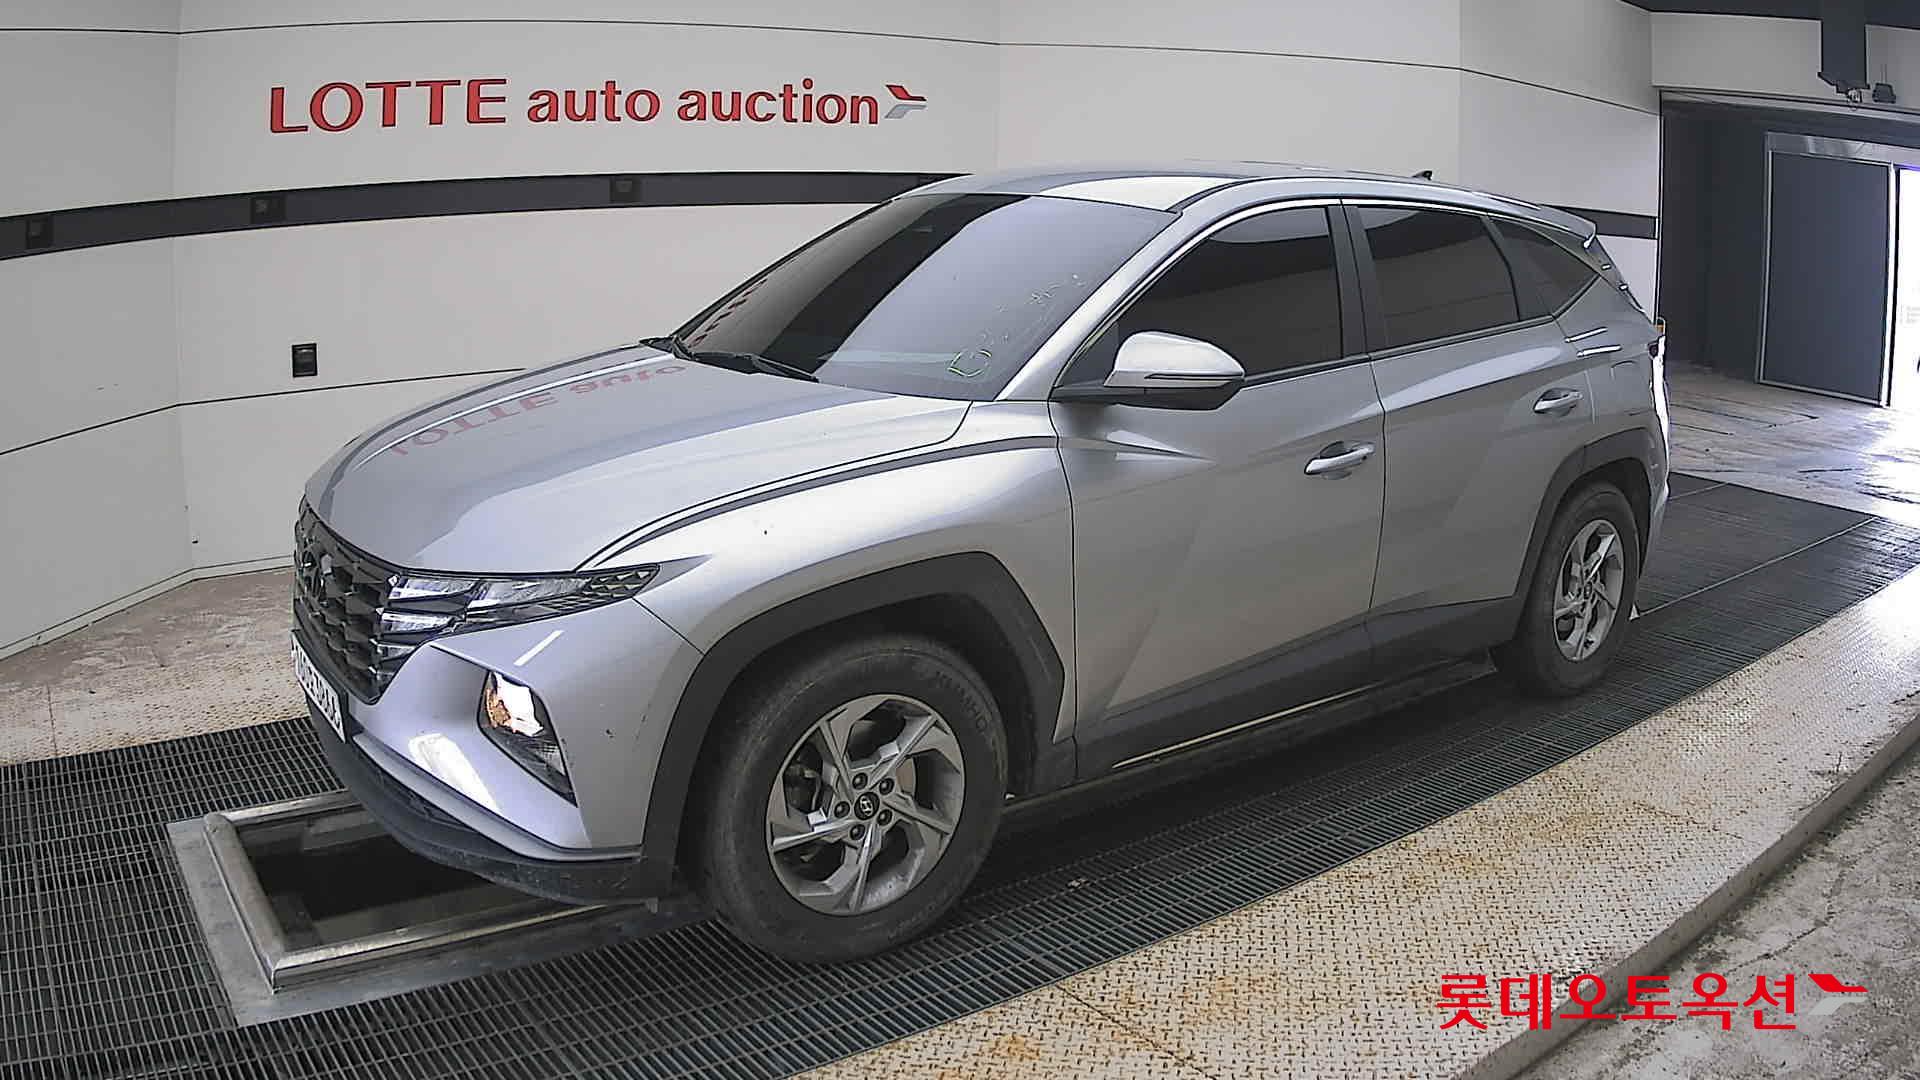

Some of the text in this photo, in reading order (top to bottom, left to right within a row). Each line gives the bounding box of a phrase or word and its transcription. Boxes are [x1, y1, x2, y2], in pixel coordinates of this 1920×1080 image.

[270, 78, 880, 134] LOTTE auto auction
